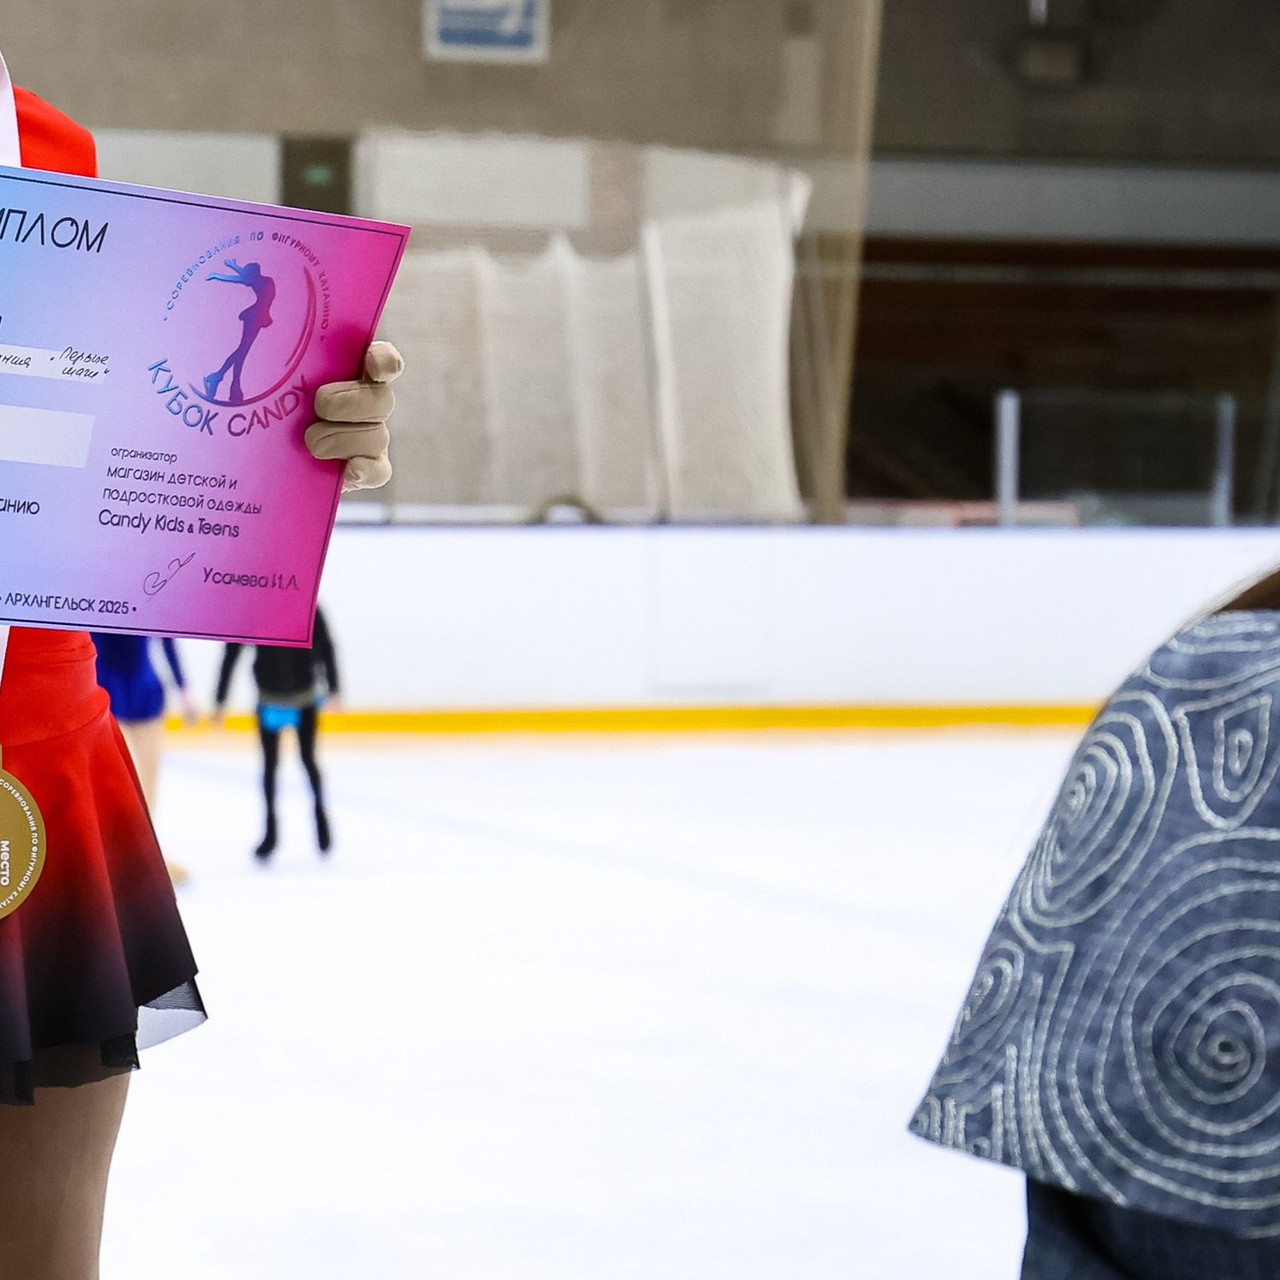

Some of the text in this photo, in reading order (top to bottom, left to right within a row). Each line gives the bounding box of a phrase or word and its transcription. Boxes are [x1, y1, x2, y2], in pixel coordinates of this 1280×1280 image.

[148, 358, 312, 437] КУБОК CANDY
[106, 466, 238, 490] магазин детской и
[102, 487, 263, 515] подростковой одежды
[98, 509, 240, 538] Candy Kids & Teens
[203, 567, 268, 589] Усачева
[4, 592, 130, 614] АРХАНГЕЛЬСК 2025
